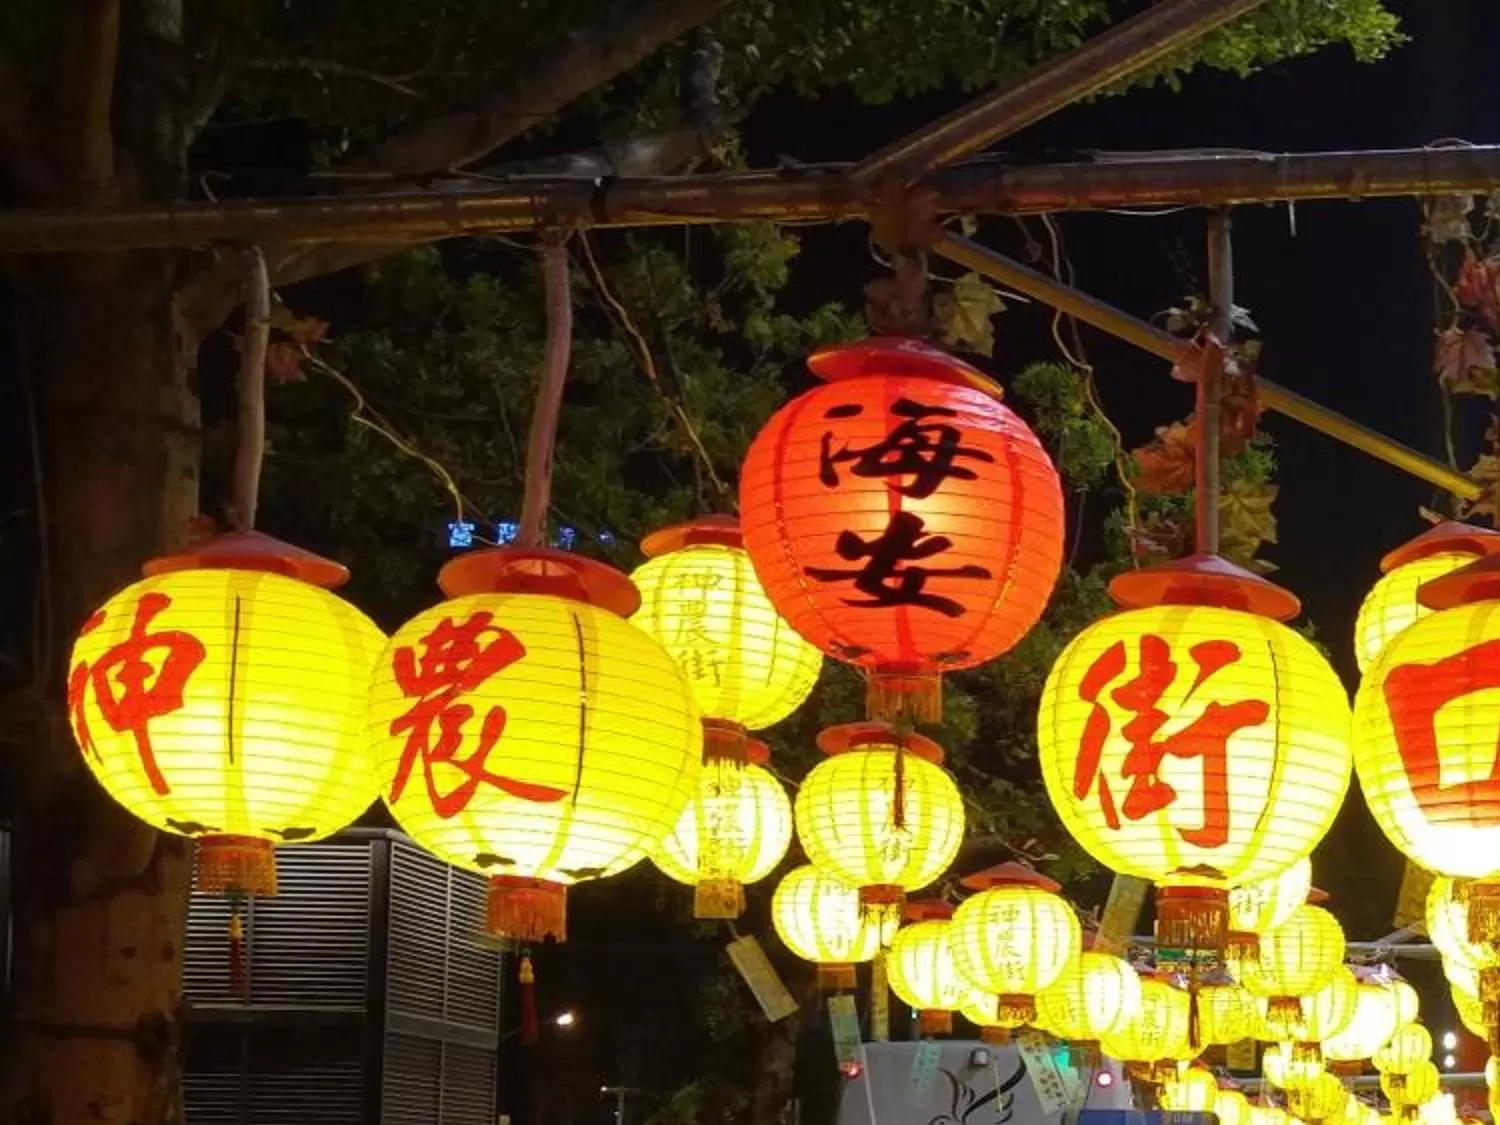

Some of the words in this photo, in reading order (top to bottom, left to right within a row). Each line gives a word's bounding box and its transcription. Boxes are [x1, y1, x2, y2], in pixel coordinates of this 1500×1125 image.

[803, 398, 993, 618] 海安
[68, 592, 206, 796] 神
[390, 612, 570, 819] 農
[1073, 633, 1270, 848] 街
